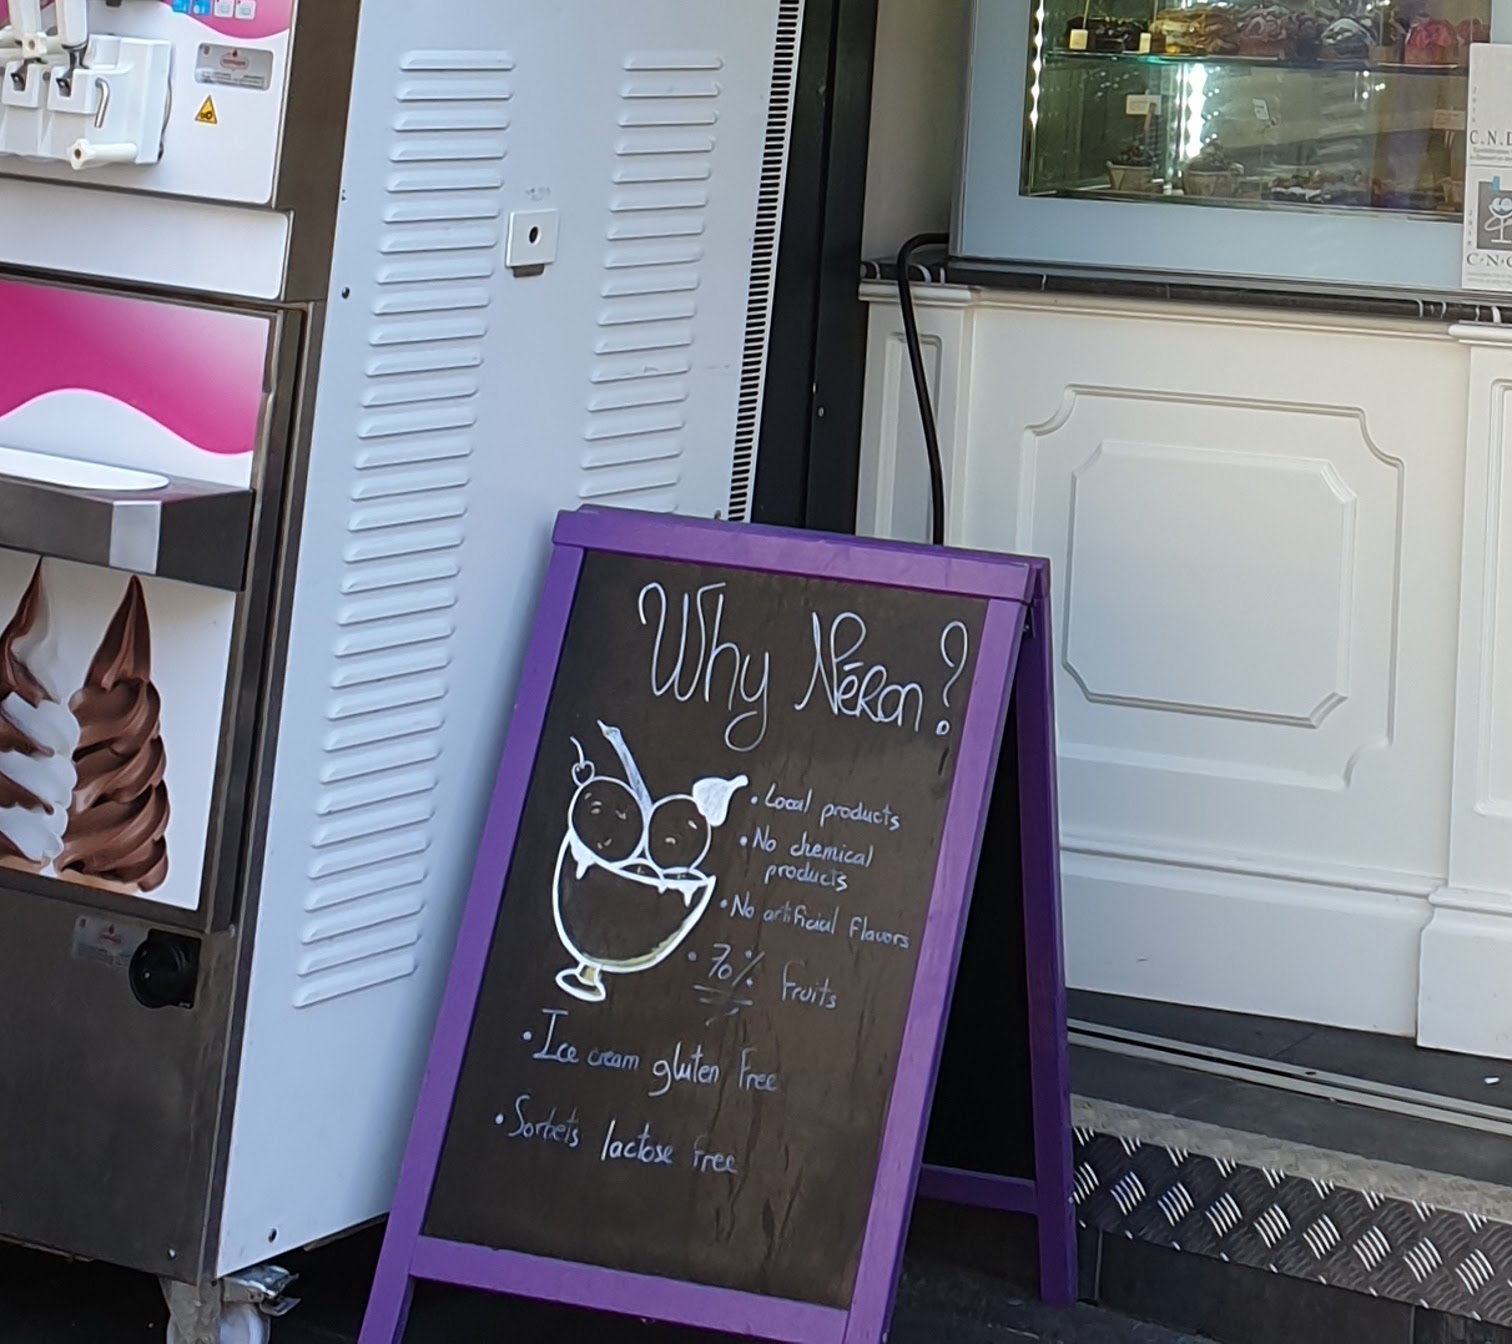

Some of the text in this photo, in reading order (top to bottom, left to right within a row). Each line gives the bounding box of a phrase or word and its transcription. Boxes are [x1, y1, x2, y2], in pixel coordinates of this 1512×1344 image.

[638, 582, 770, 752] Why
[765, 783, 900, 831] Local products
[752, 825, 873, 867] No chemical
[765, 863, 848, 891] products
[730, 892, 754, 918] No
[763, 901, 839, 935] artificial
[708, 943, 765, 986] 70%
[533, 1008, 579, 1063] Ice
[587, 1048, 640, 1070] cream
[648, 1041, 720, 1096] gluten
[508, 1094, 580, 1148] Sorbets
[601, 1119, 673, 1164] lactose
